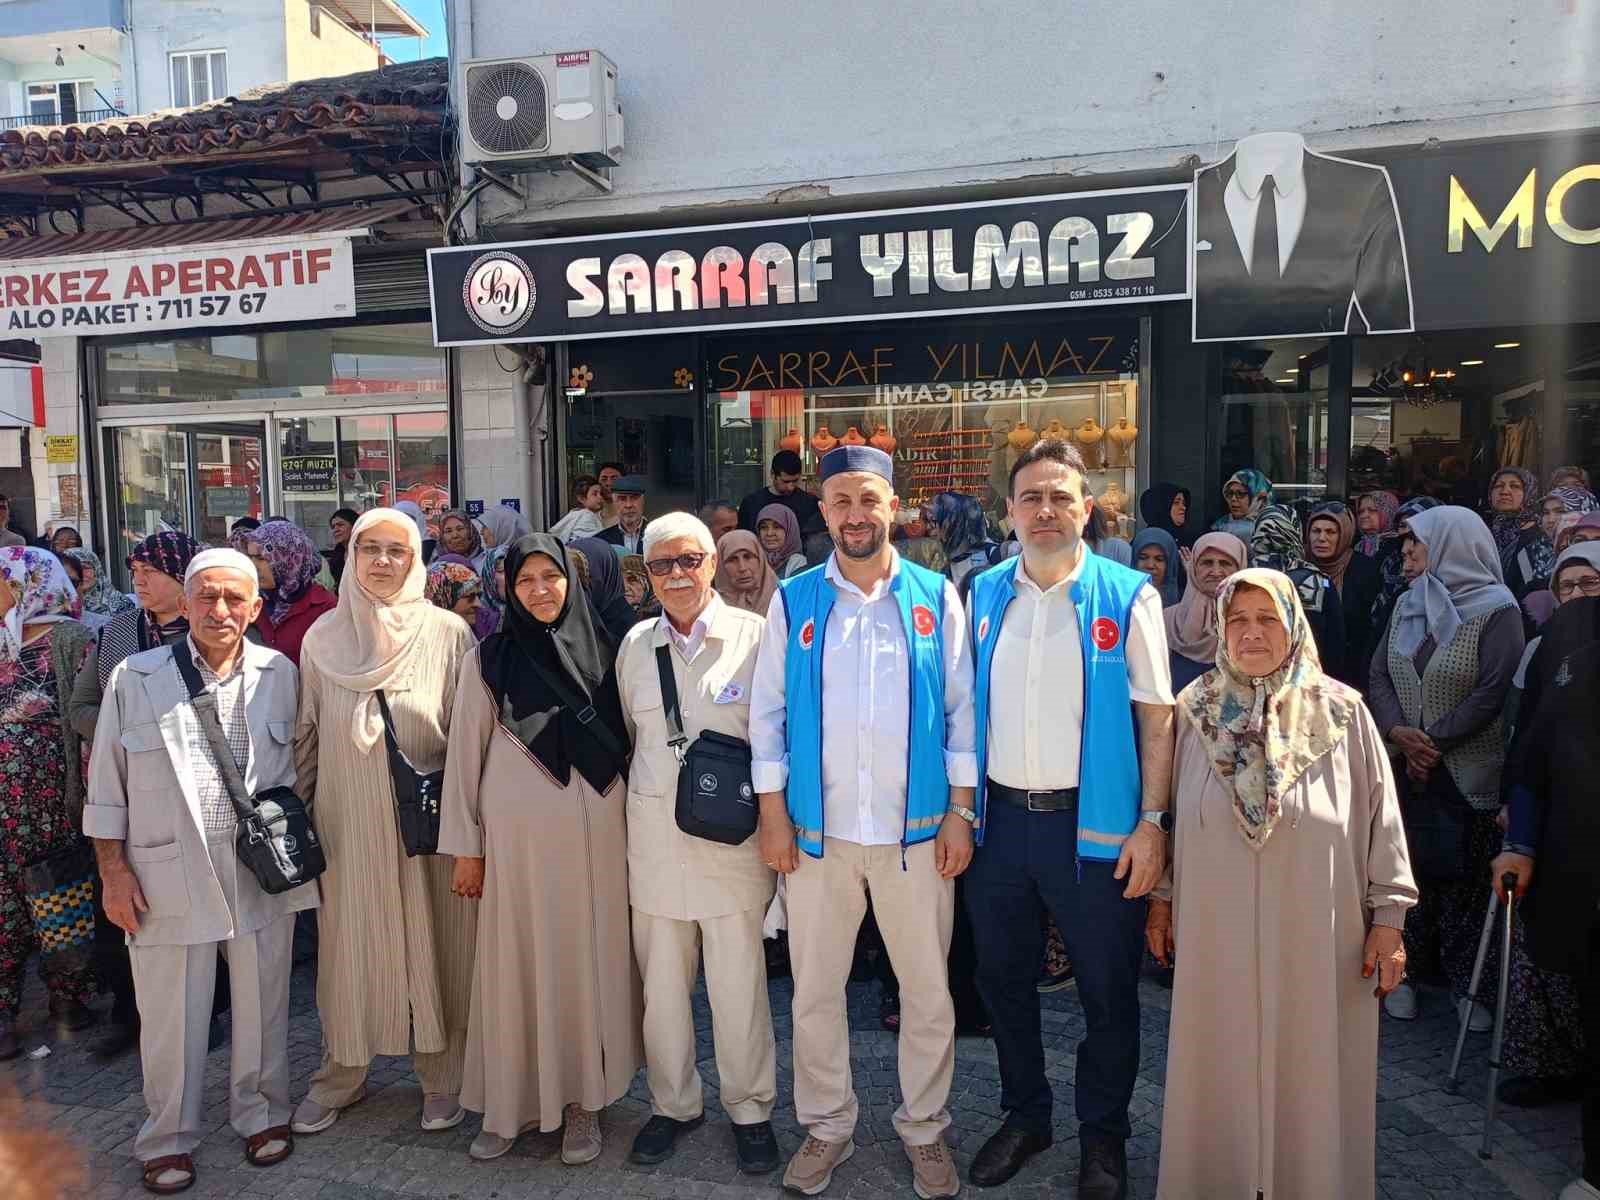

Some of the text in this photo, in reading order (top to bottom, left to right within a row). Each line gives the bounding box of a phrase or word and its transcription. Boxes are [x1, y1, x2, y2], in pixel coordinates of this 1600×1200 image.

[566, 212, 1155, 318] SARRAF YILMAZ
[0, 268, 111, 308] RKEZ
[1070, 290, 1086, 299] GSM
[1093, 288, 1113, 298] 0535
[1115, 287, 1130, 297] 438
[1132, 286, 1142, 295] 71
[1145, 285, 1155, 295] 10
[8, 309, 56, 330] ALO
[62, 303, 139, 327] PAKET
[158, 298, 193, 321] 711
[199, 296, 232, 317] 57
[239, 292, 268, 315] 67
[716, 336, 1118, 392] SARRAF YILMAZ
[469, 503, 479, 513] 55
